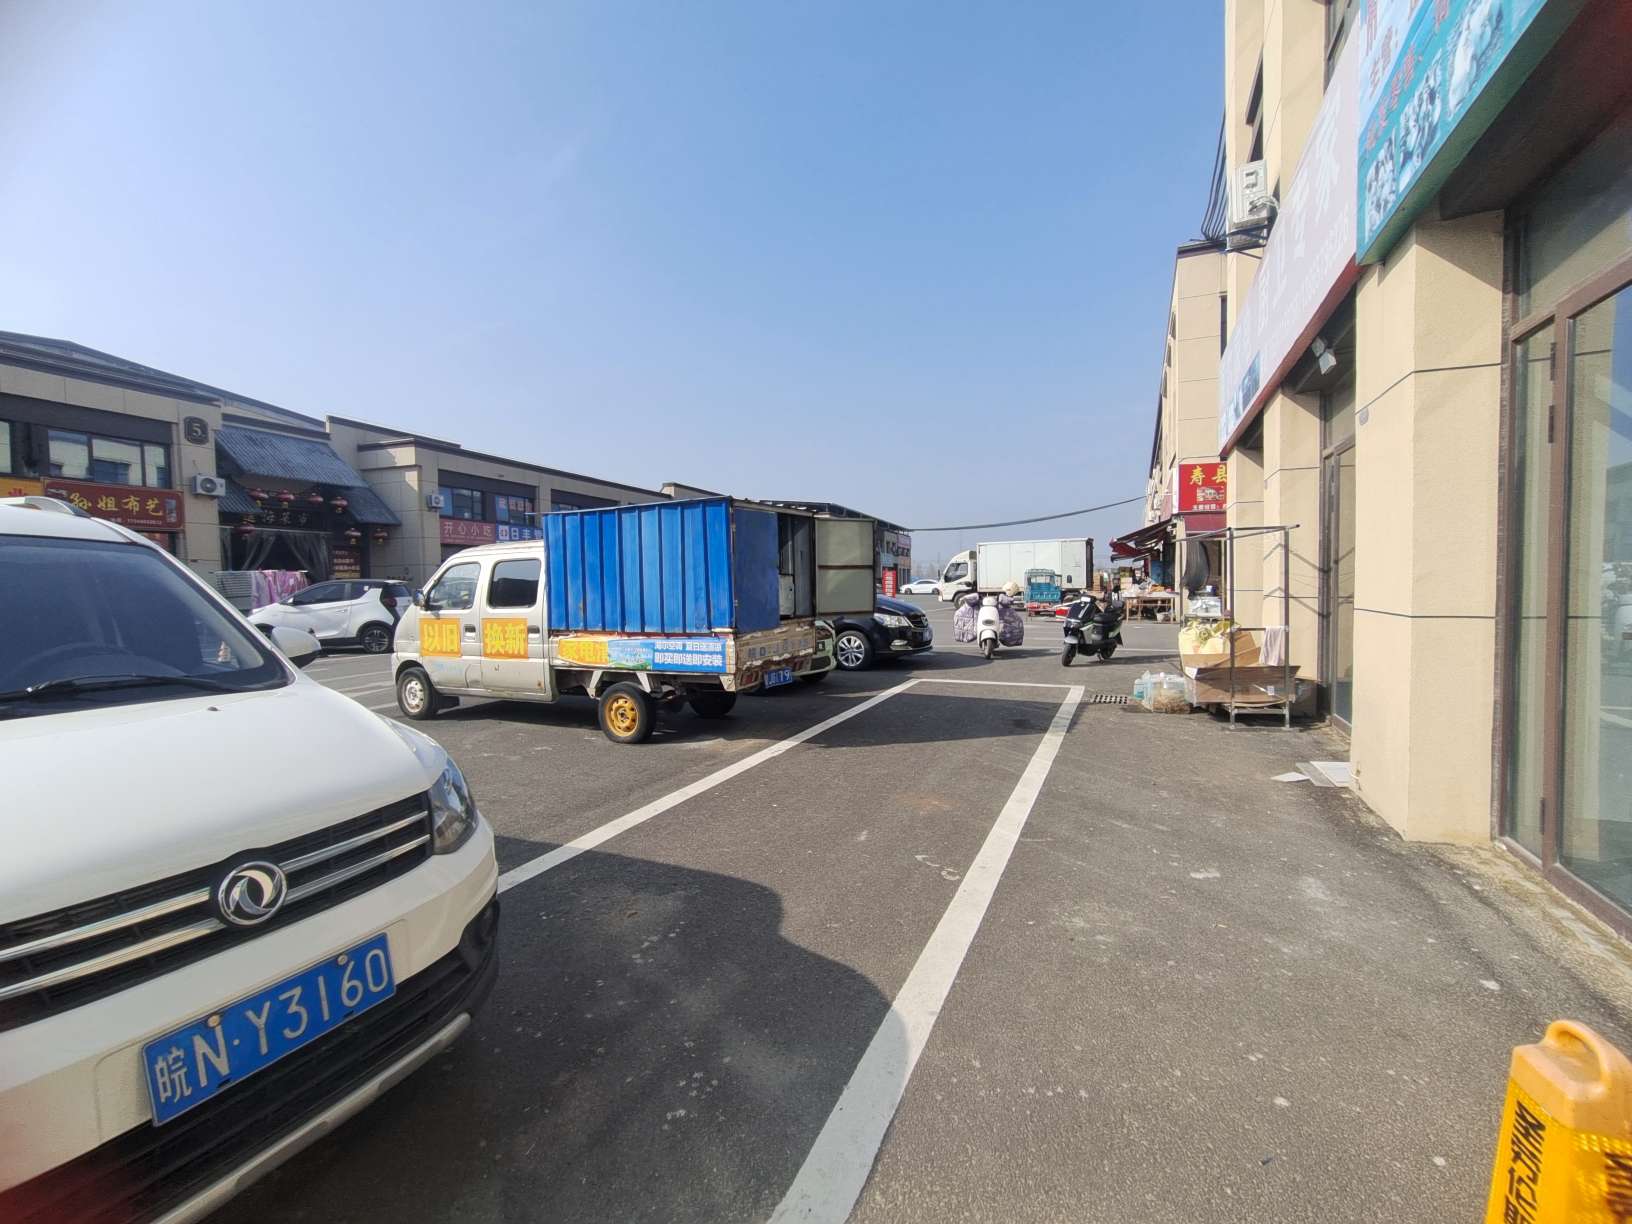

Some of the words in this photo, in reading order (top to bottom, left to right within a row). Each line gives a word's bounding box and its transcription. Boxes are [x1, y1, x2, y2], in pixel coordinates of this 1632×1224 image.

[1189, 464, 1228, 487] 寿县
[443, 520, 492, 538] 开心小吃
[423, 623, 459, 653] 以旧
[485, 622, 526, 655] 换新
[153, 947, 390, 1105] 皖N·Y3160
